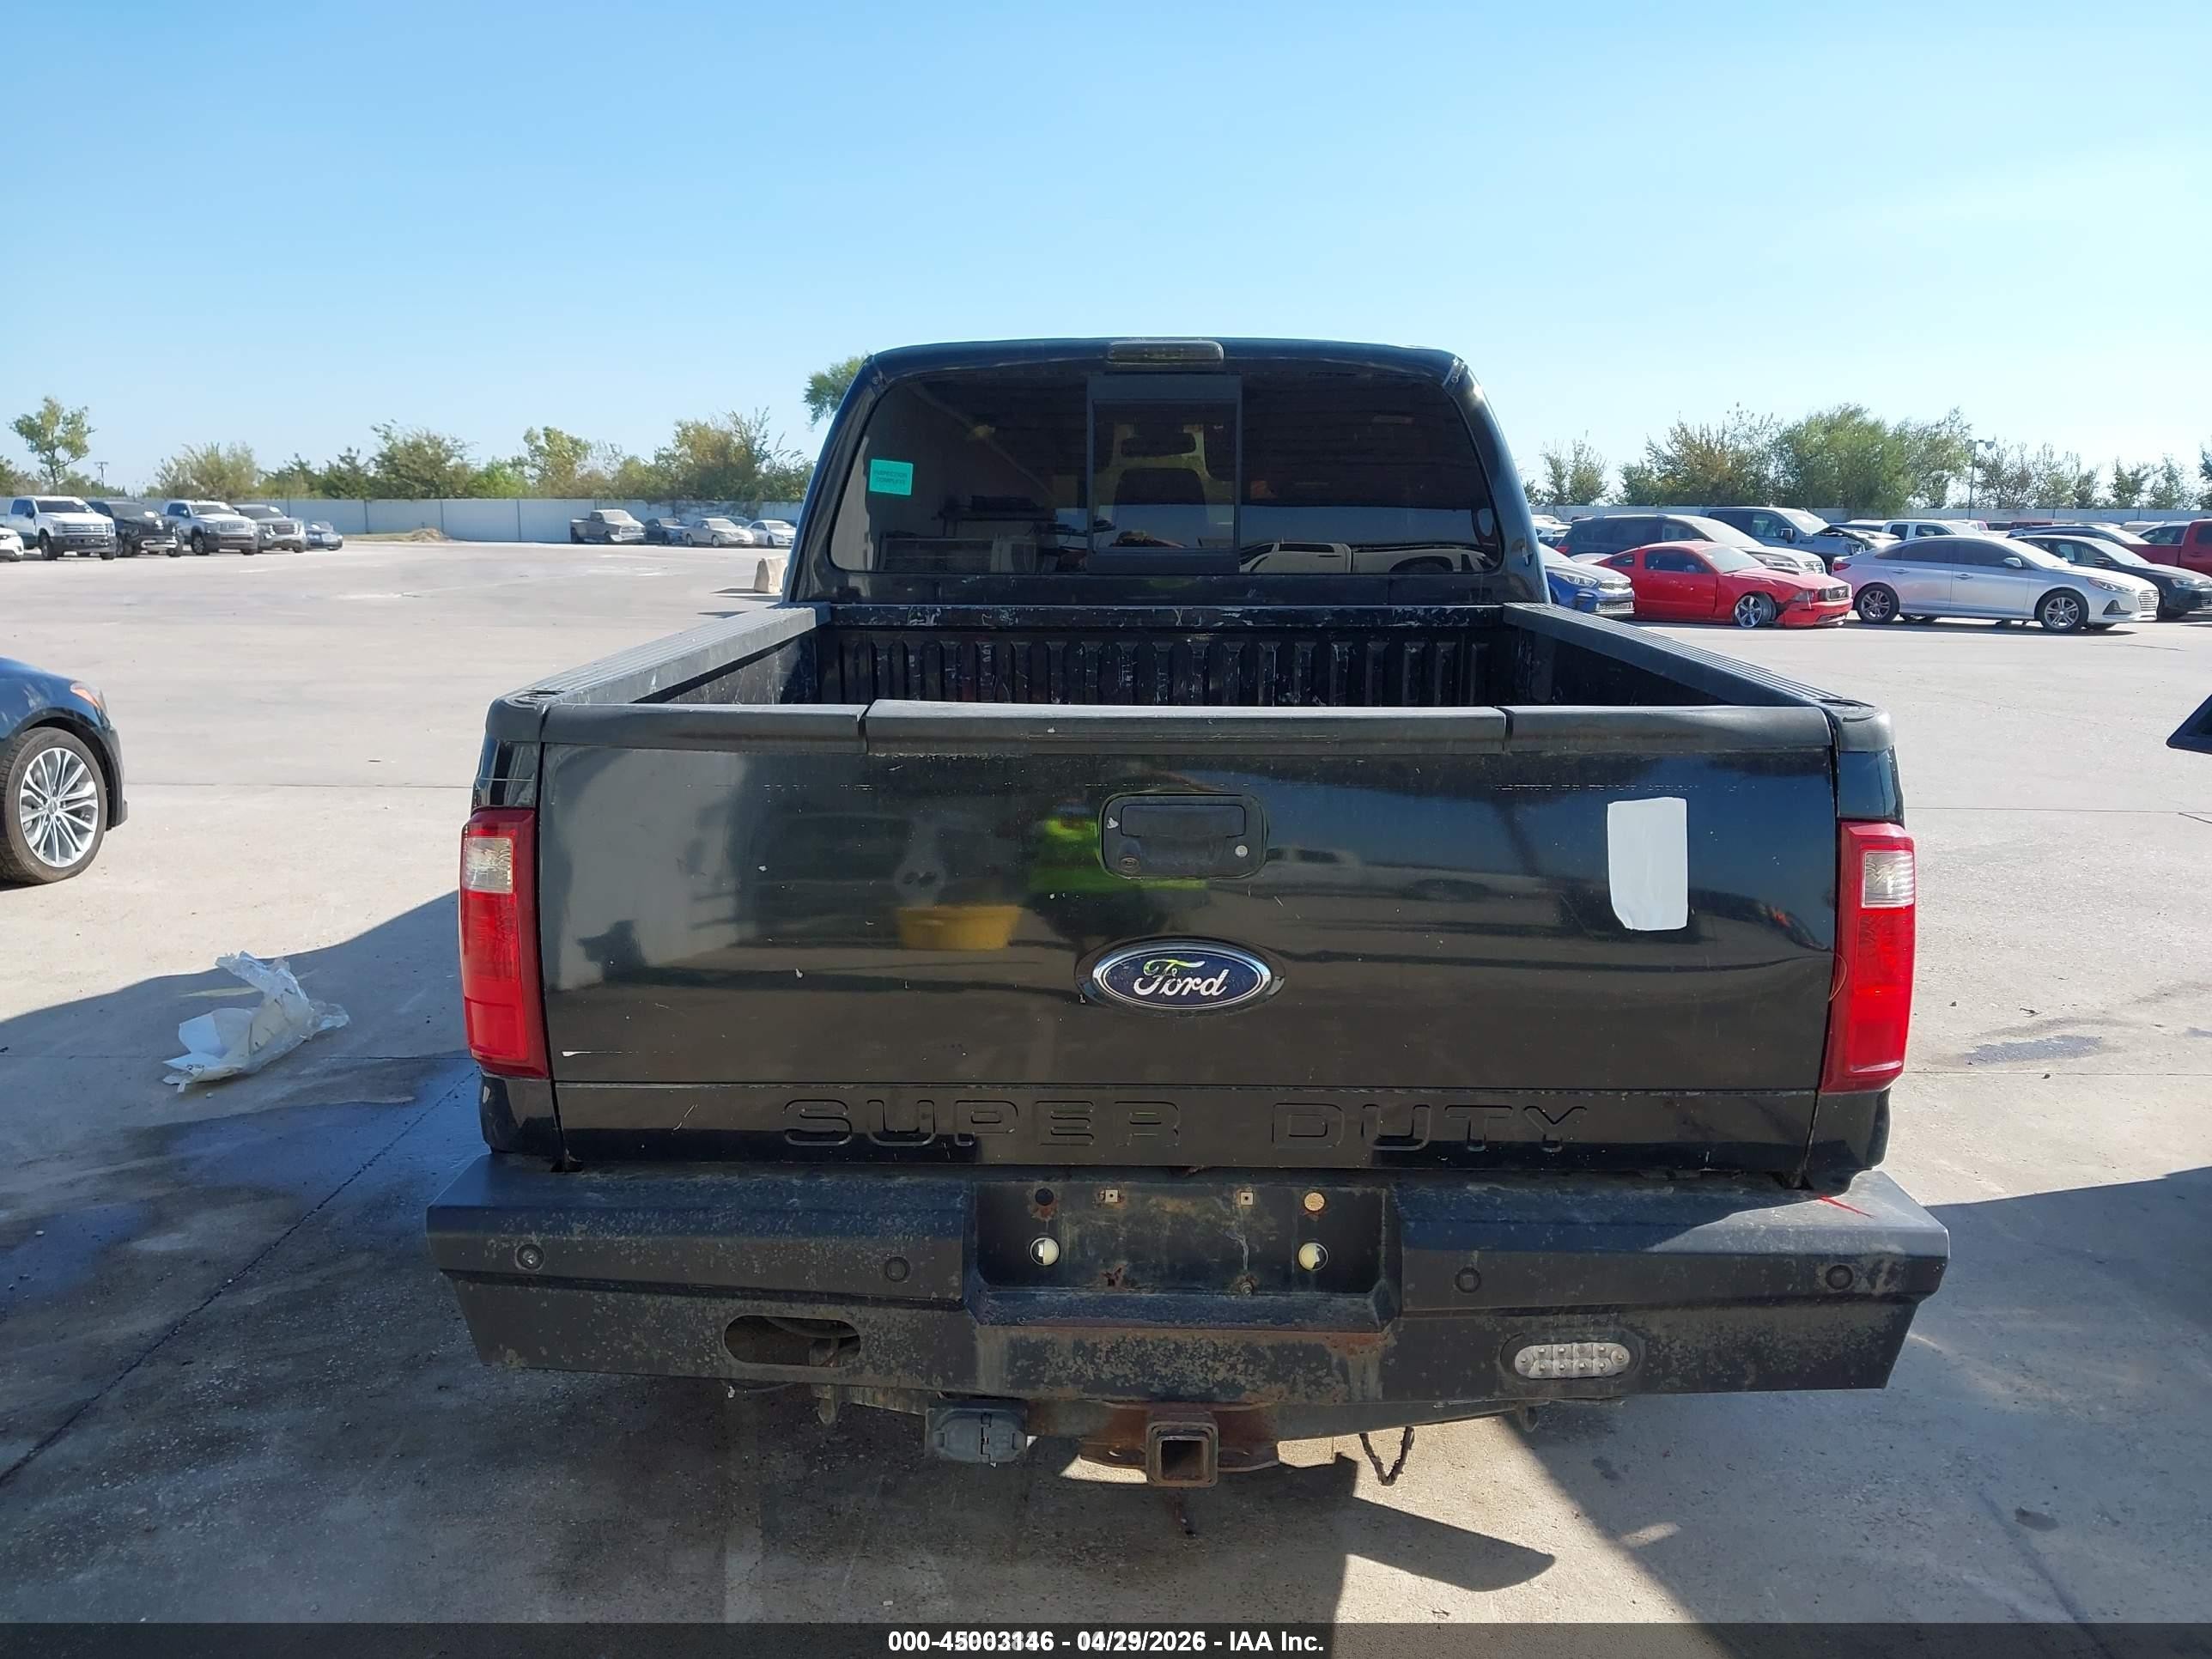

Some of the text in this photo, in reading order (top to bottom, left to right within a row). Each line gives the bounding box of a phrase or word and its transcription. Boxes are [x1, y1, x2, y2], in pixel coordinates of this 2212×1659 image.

[1133, 958, 1230, 996] Ford
[783, 1098, 1588, 1153] SUPER DUTY
